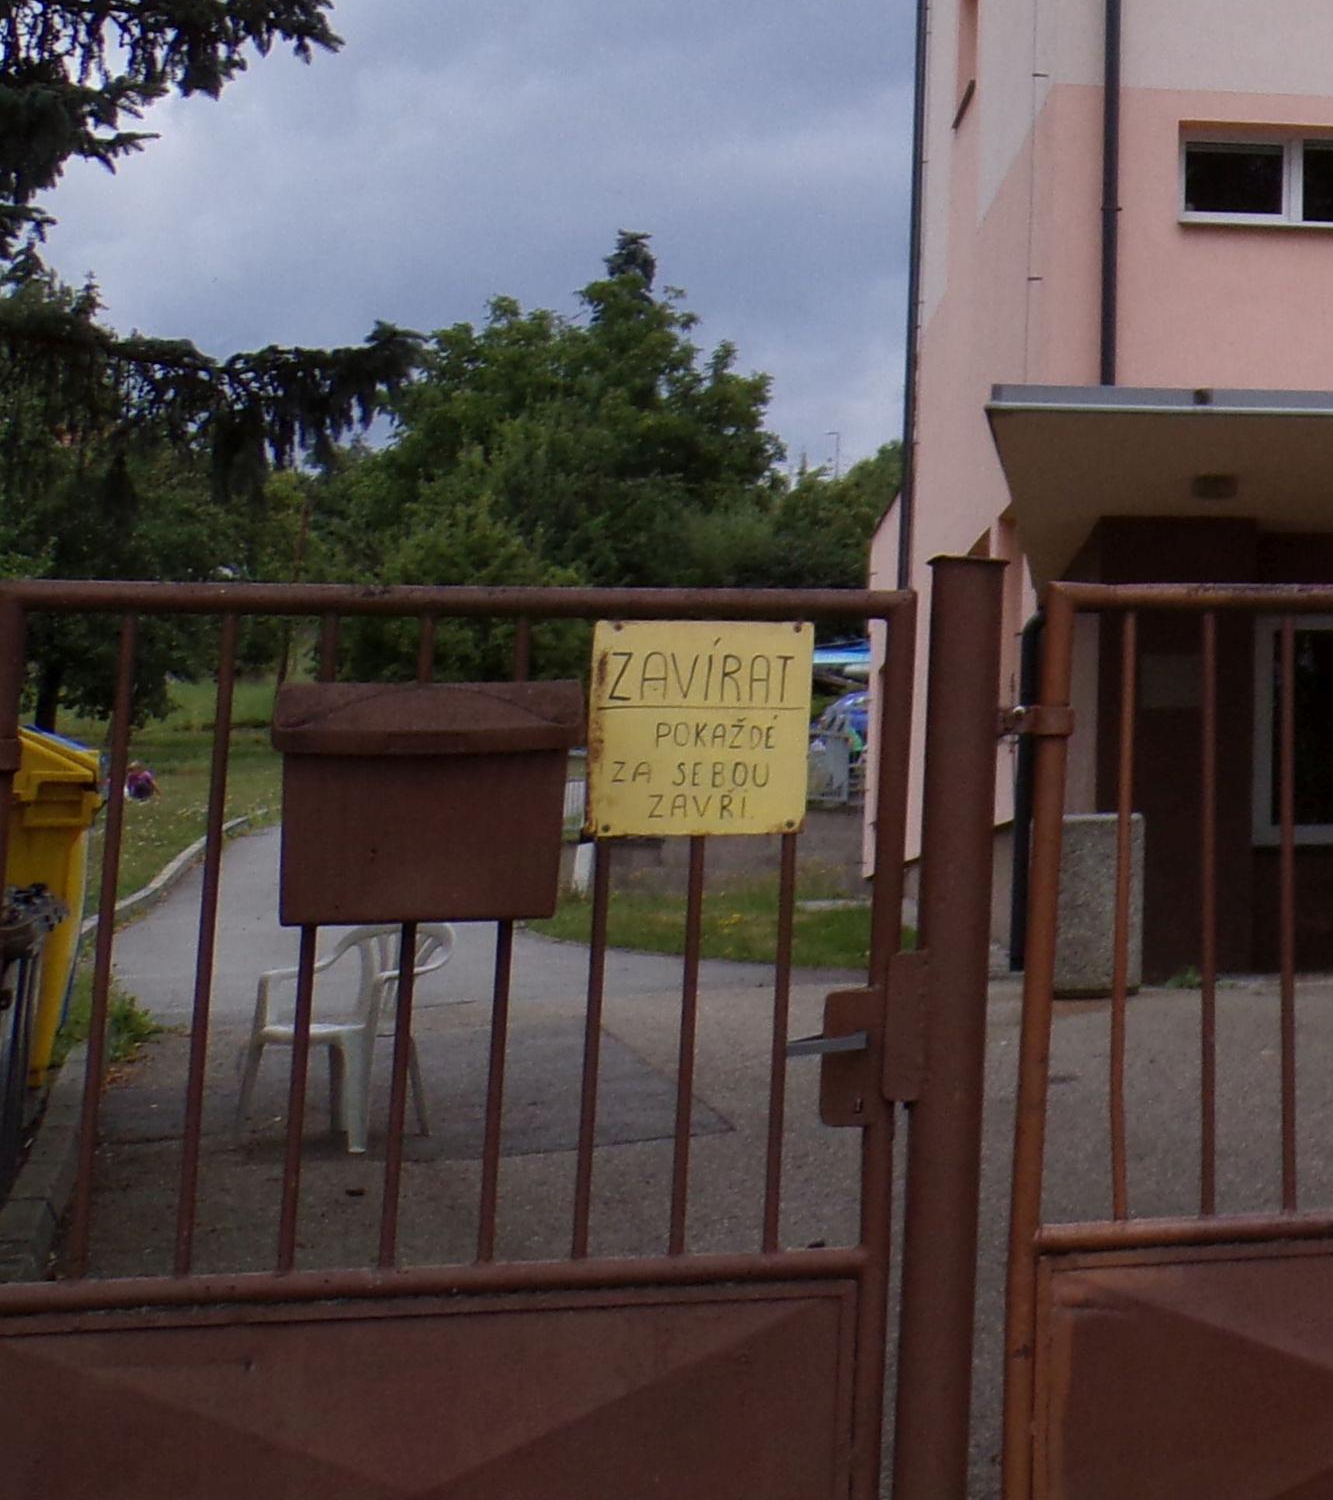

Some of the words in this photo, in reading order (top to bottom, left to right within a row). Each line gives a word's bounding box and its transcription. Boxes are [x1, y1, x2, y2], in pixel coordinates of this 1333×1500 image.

[608, 637, 794, 702] ZAVÍRAT
[655, 714, 779, 750] POKAŽDÉ
[611, 761, 651, 784] ZA
[672, 761, 770, 788] SEBOU
